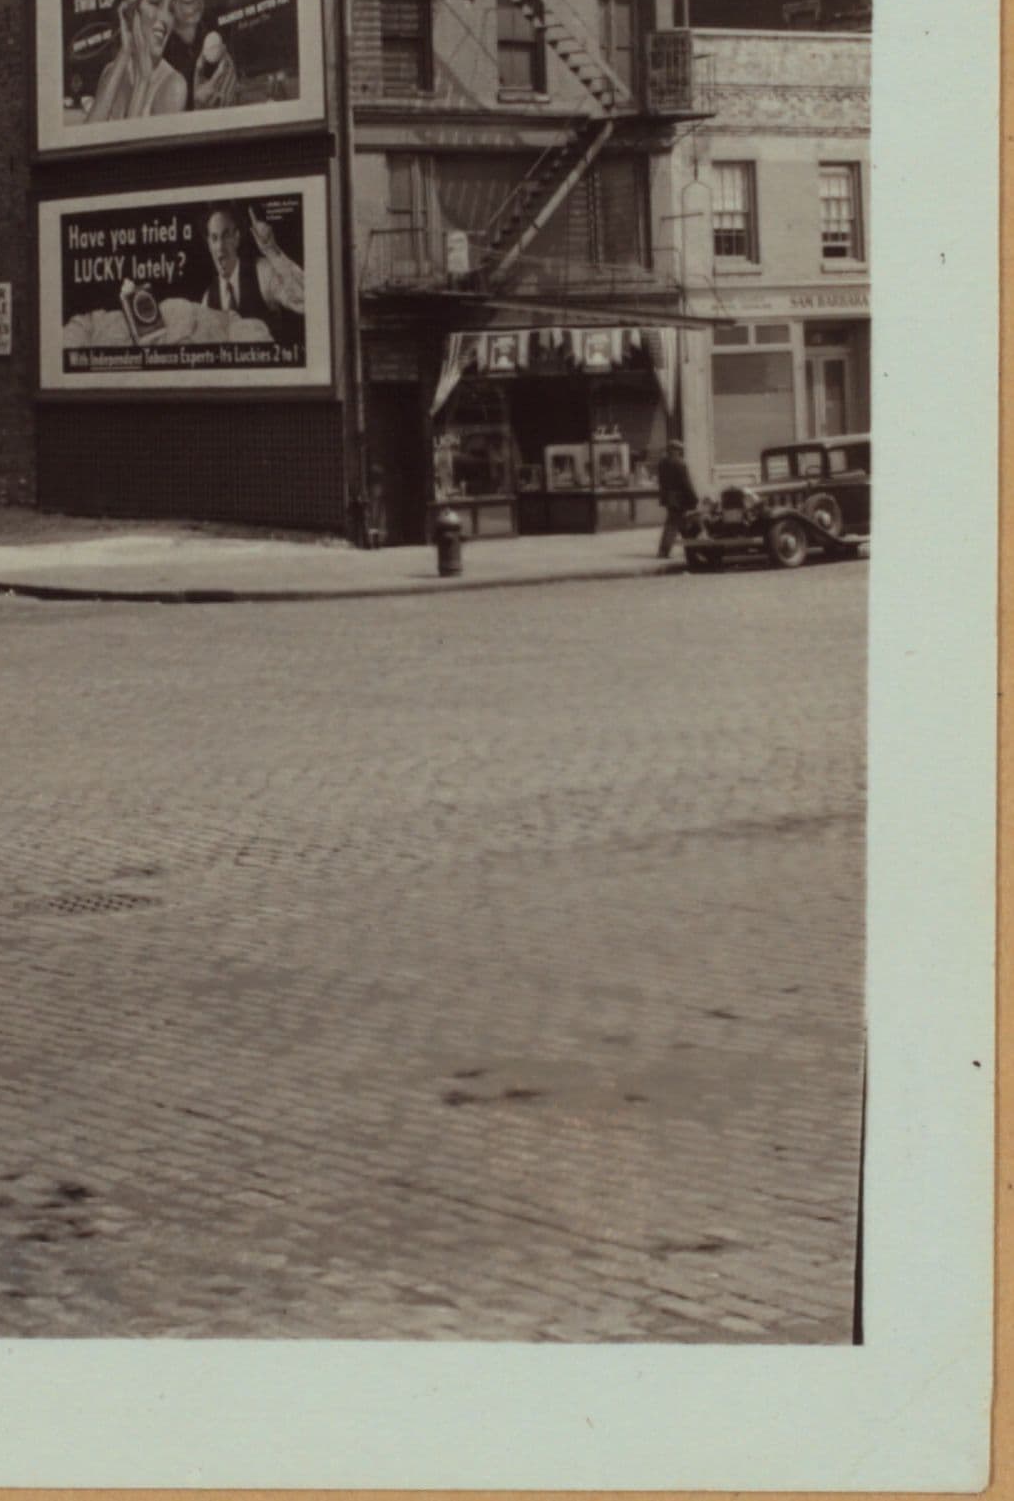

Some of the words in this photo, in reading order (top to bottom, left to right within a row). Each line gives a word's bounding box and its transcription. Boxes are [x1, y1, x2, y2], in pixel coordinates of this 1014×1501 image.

[68, 224, 105, 250] Have
[110, 228, 137, 253] you
[142, 215, 178, 244] tried
[183, 224, 192, 240] a
[74, 255, 125, 283] LUCKY
[132, 251, 187, 284] lately?
